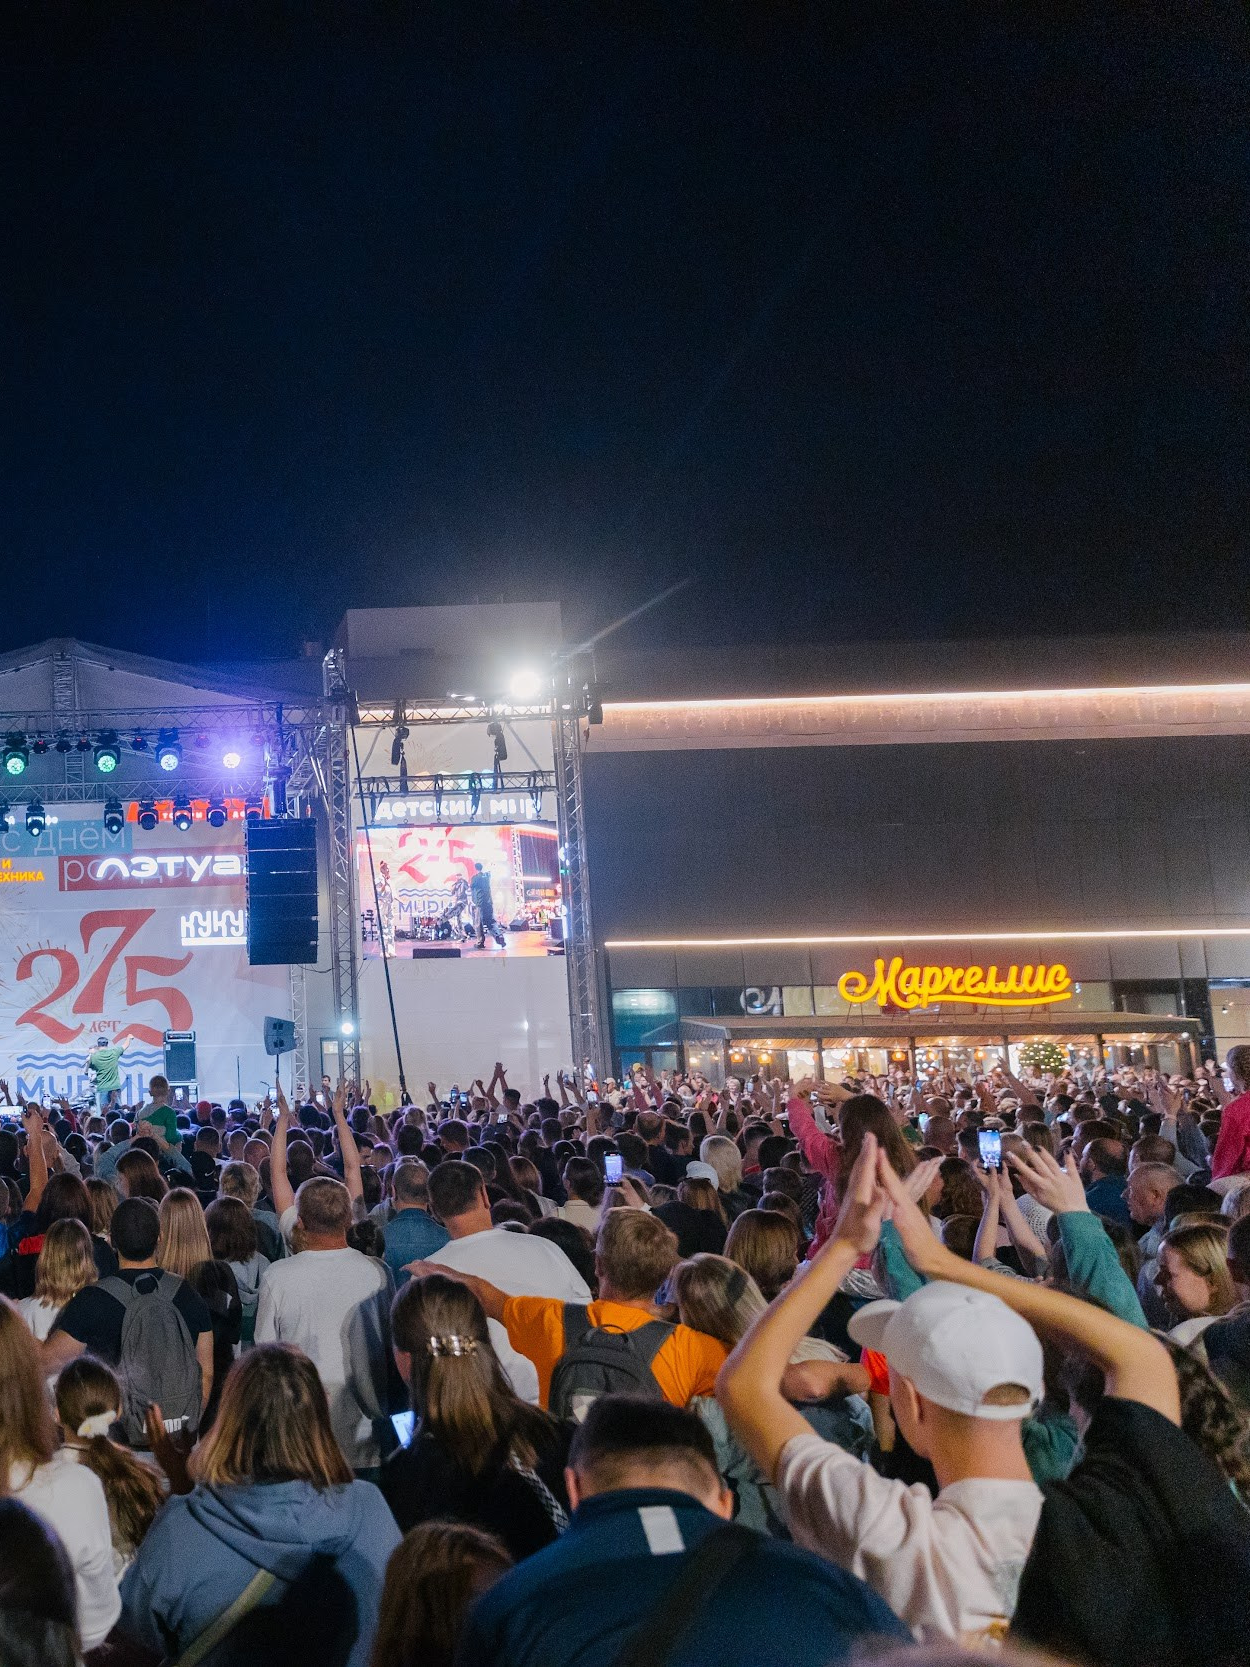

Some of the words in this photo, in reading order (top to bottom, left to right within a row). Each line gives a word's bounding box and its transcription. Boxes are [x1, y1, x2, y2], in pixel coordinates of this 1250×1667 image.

[2, 859, 12, 869] И
[15, 908, 194, 1047] 275
[838, 956, 1072, 1009] Марчеллис
